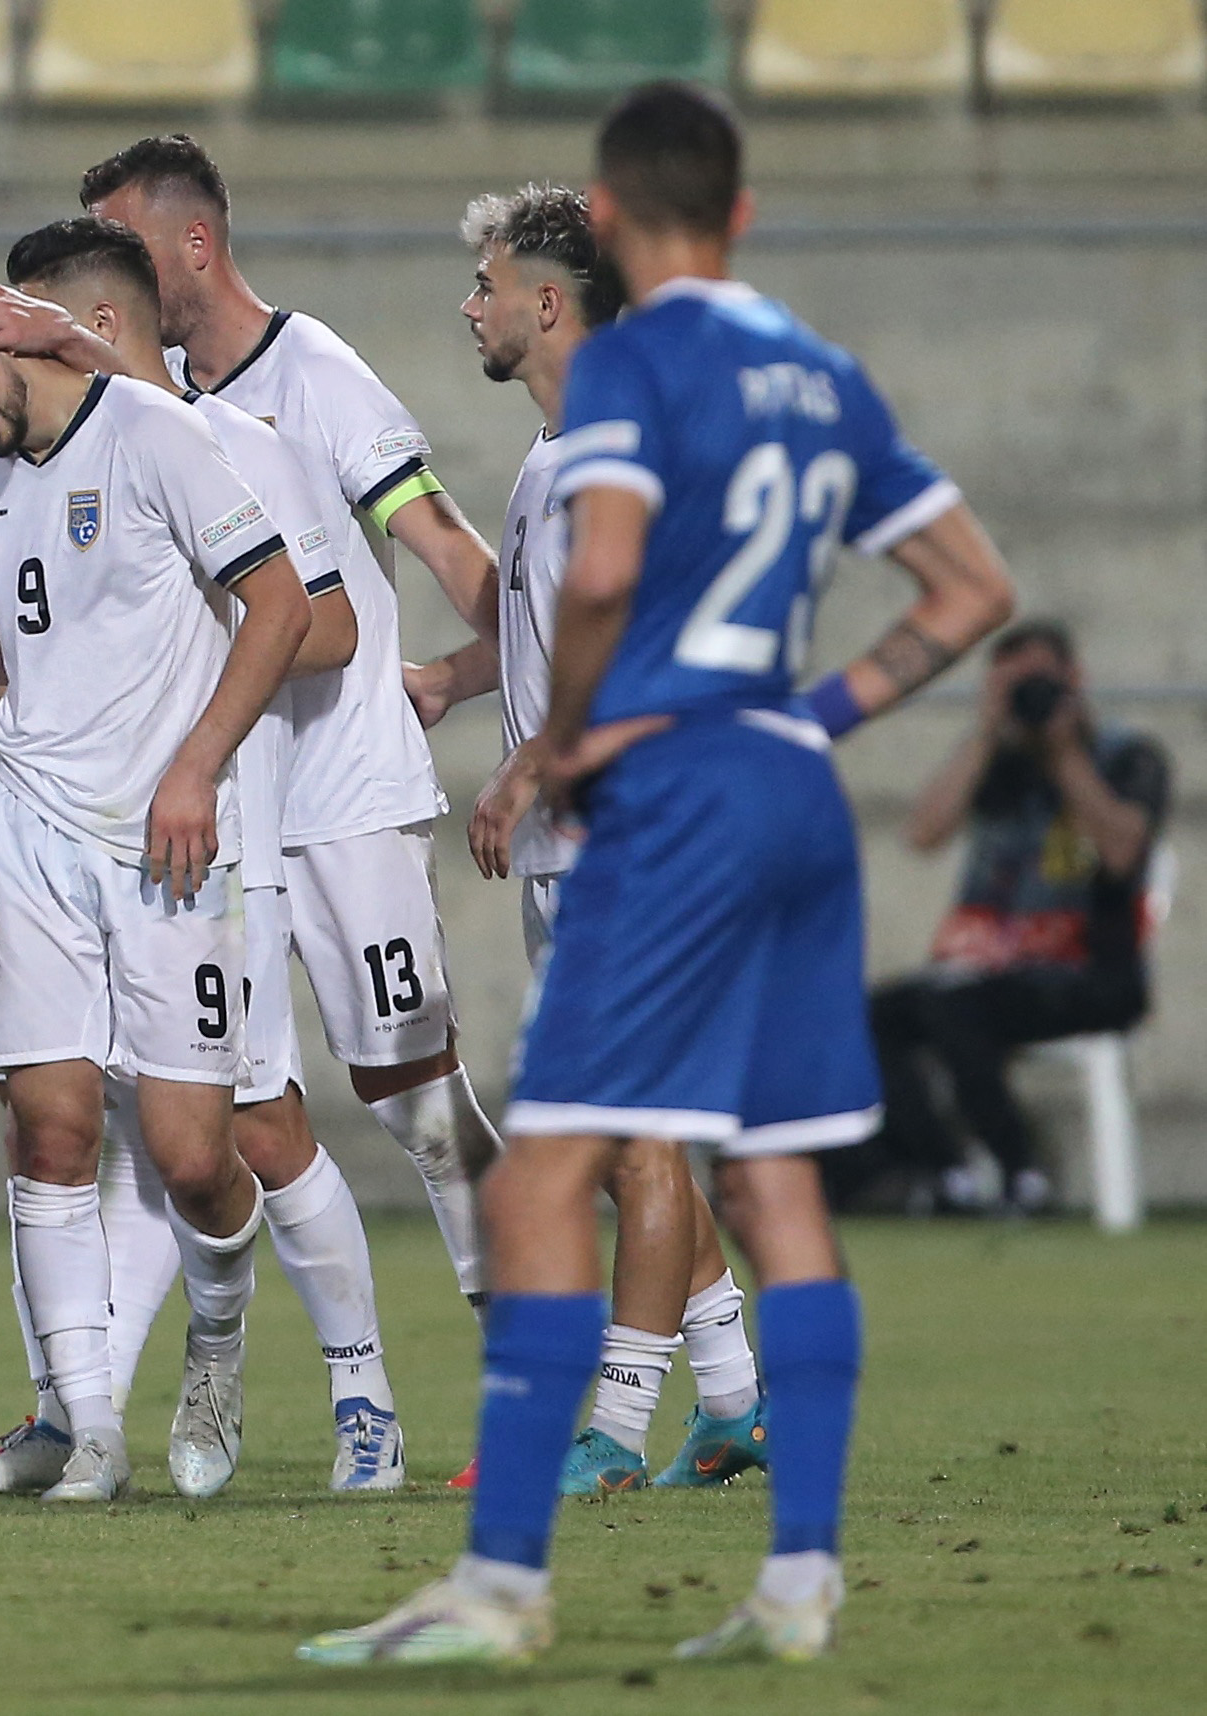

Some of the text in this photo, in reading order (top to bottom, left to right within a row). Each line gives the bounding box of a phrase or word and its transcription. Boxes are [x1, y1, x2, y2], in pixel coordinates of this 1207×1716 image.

[18, 557, 52, 635] 9
[194, 963, 227, 1039] 9
[364, 937, 424, 1017] 13
